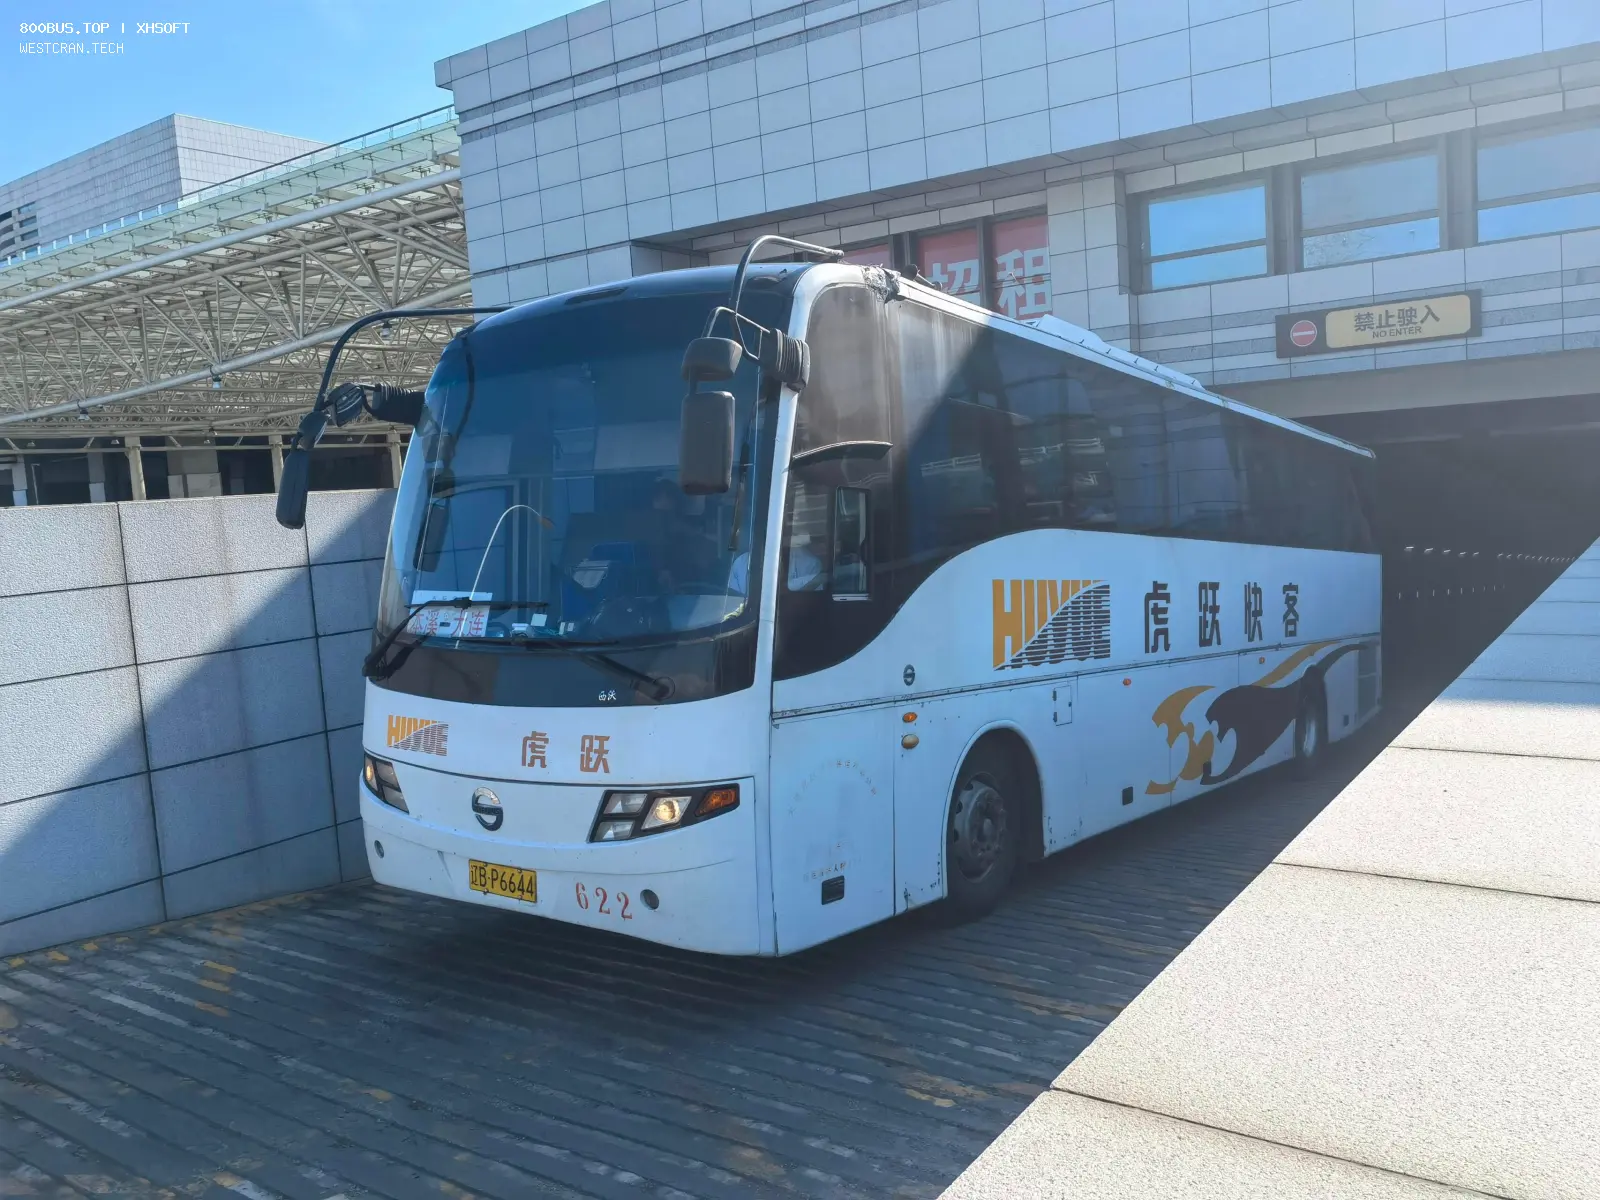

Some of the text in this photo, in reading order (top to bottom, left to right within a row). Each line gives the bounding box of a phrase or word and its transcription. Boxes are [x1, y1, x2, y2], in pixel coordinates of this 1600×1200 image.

[1354, 304, 1440, 332] 禁止驶入
[1372, 325, 1422, 339] NO ENTER
[992, 579, 1299, 671] HUYUE 虎跃快客
[386, 714, 611, 774] HUYUE 虎跃
[575, 881, 633, 921] 622
